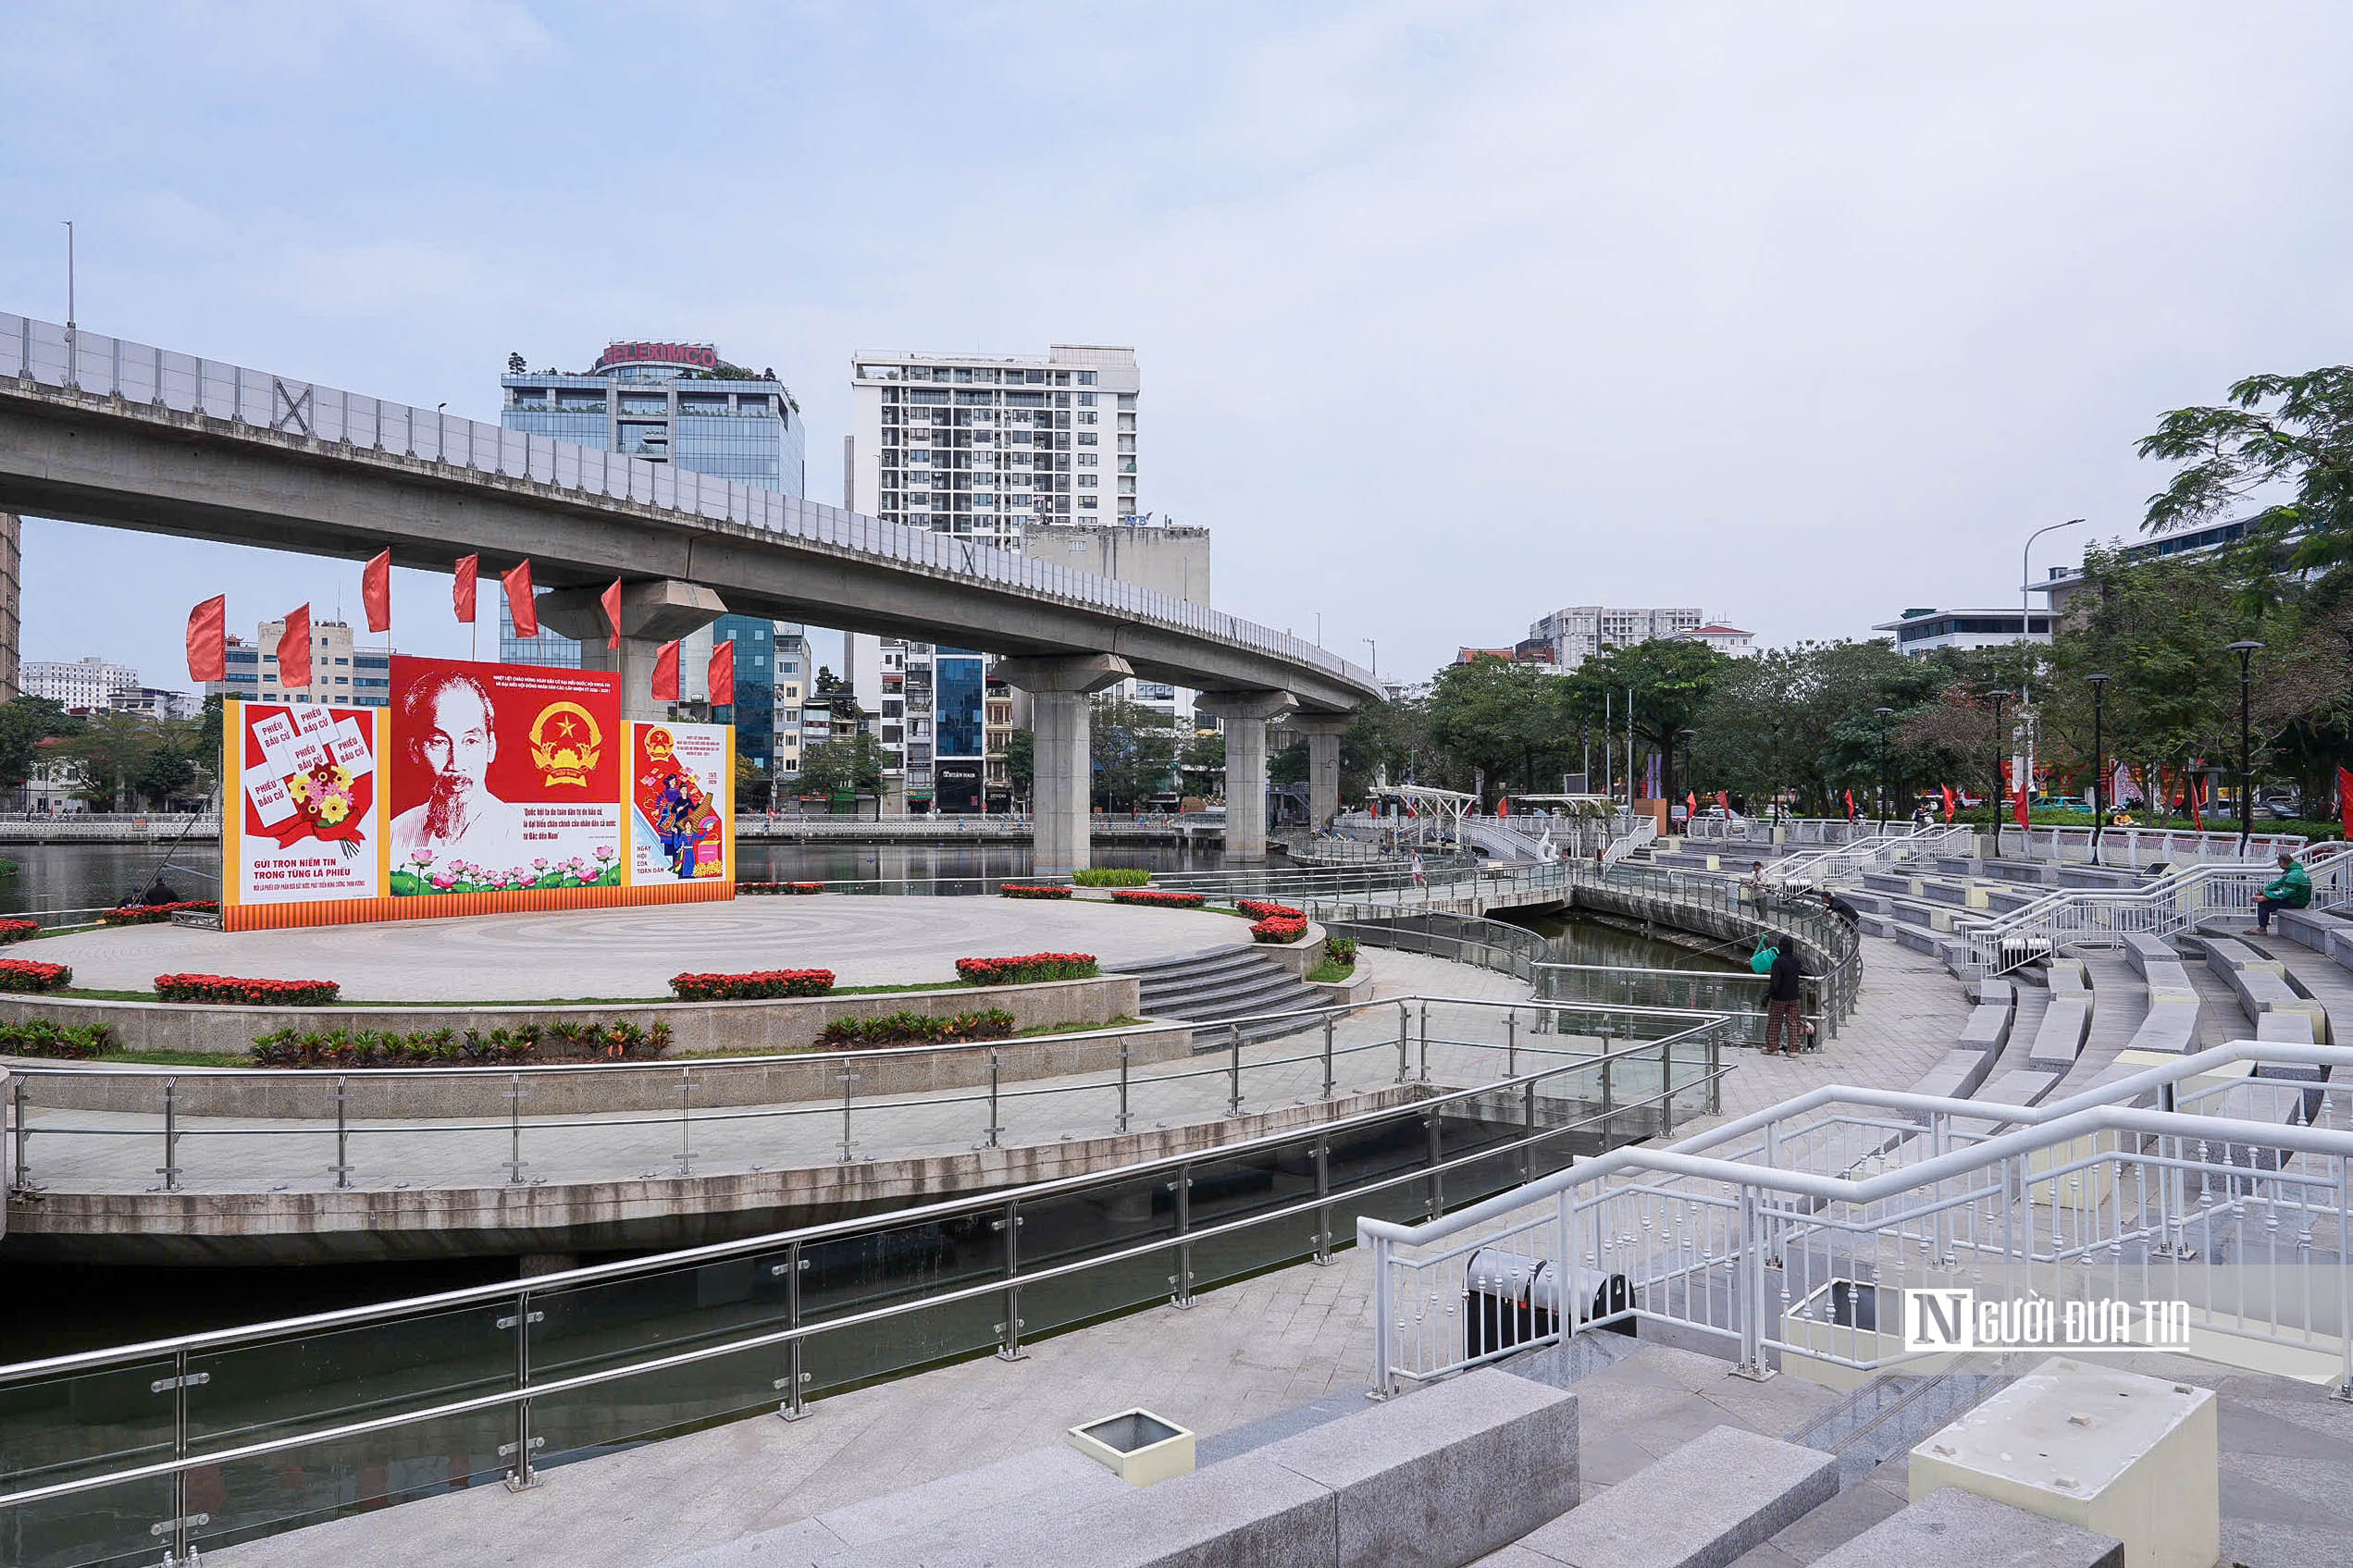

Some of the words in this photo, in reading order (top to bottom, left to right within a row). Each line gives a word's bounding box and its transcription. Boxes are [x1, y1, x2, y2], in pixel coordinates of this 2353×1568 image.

[604, 343, 717, 367] GELEXIMCO
[301, 708, 322, 722] PHIẾU
[262, 721, 283, 735] PHIẾU
[303, 723, 319, 734] BẦU
[319, 717, 329, 728] CỬ
[265, 735, 280, 748] BẦU
[280, 730, 291, 742] CỬ
[338, 737, 358, 751] PHIẾU
[295, 745, 316, 759] PHIẾU
[340, 751, 355, 763] BẦU
[355, 745, 365, 757] CỬ
[297, 759, 313, 771] BẦU
[313, 754, 324, 765] CỬ
[255, 780, 277, 795] PHIẾU
[258, 794, 274, 807] BẦU
[274, 789, 285, 801] CỬ
